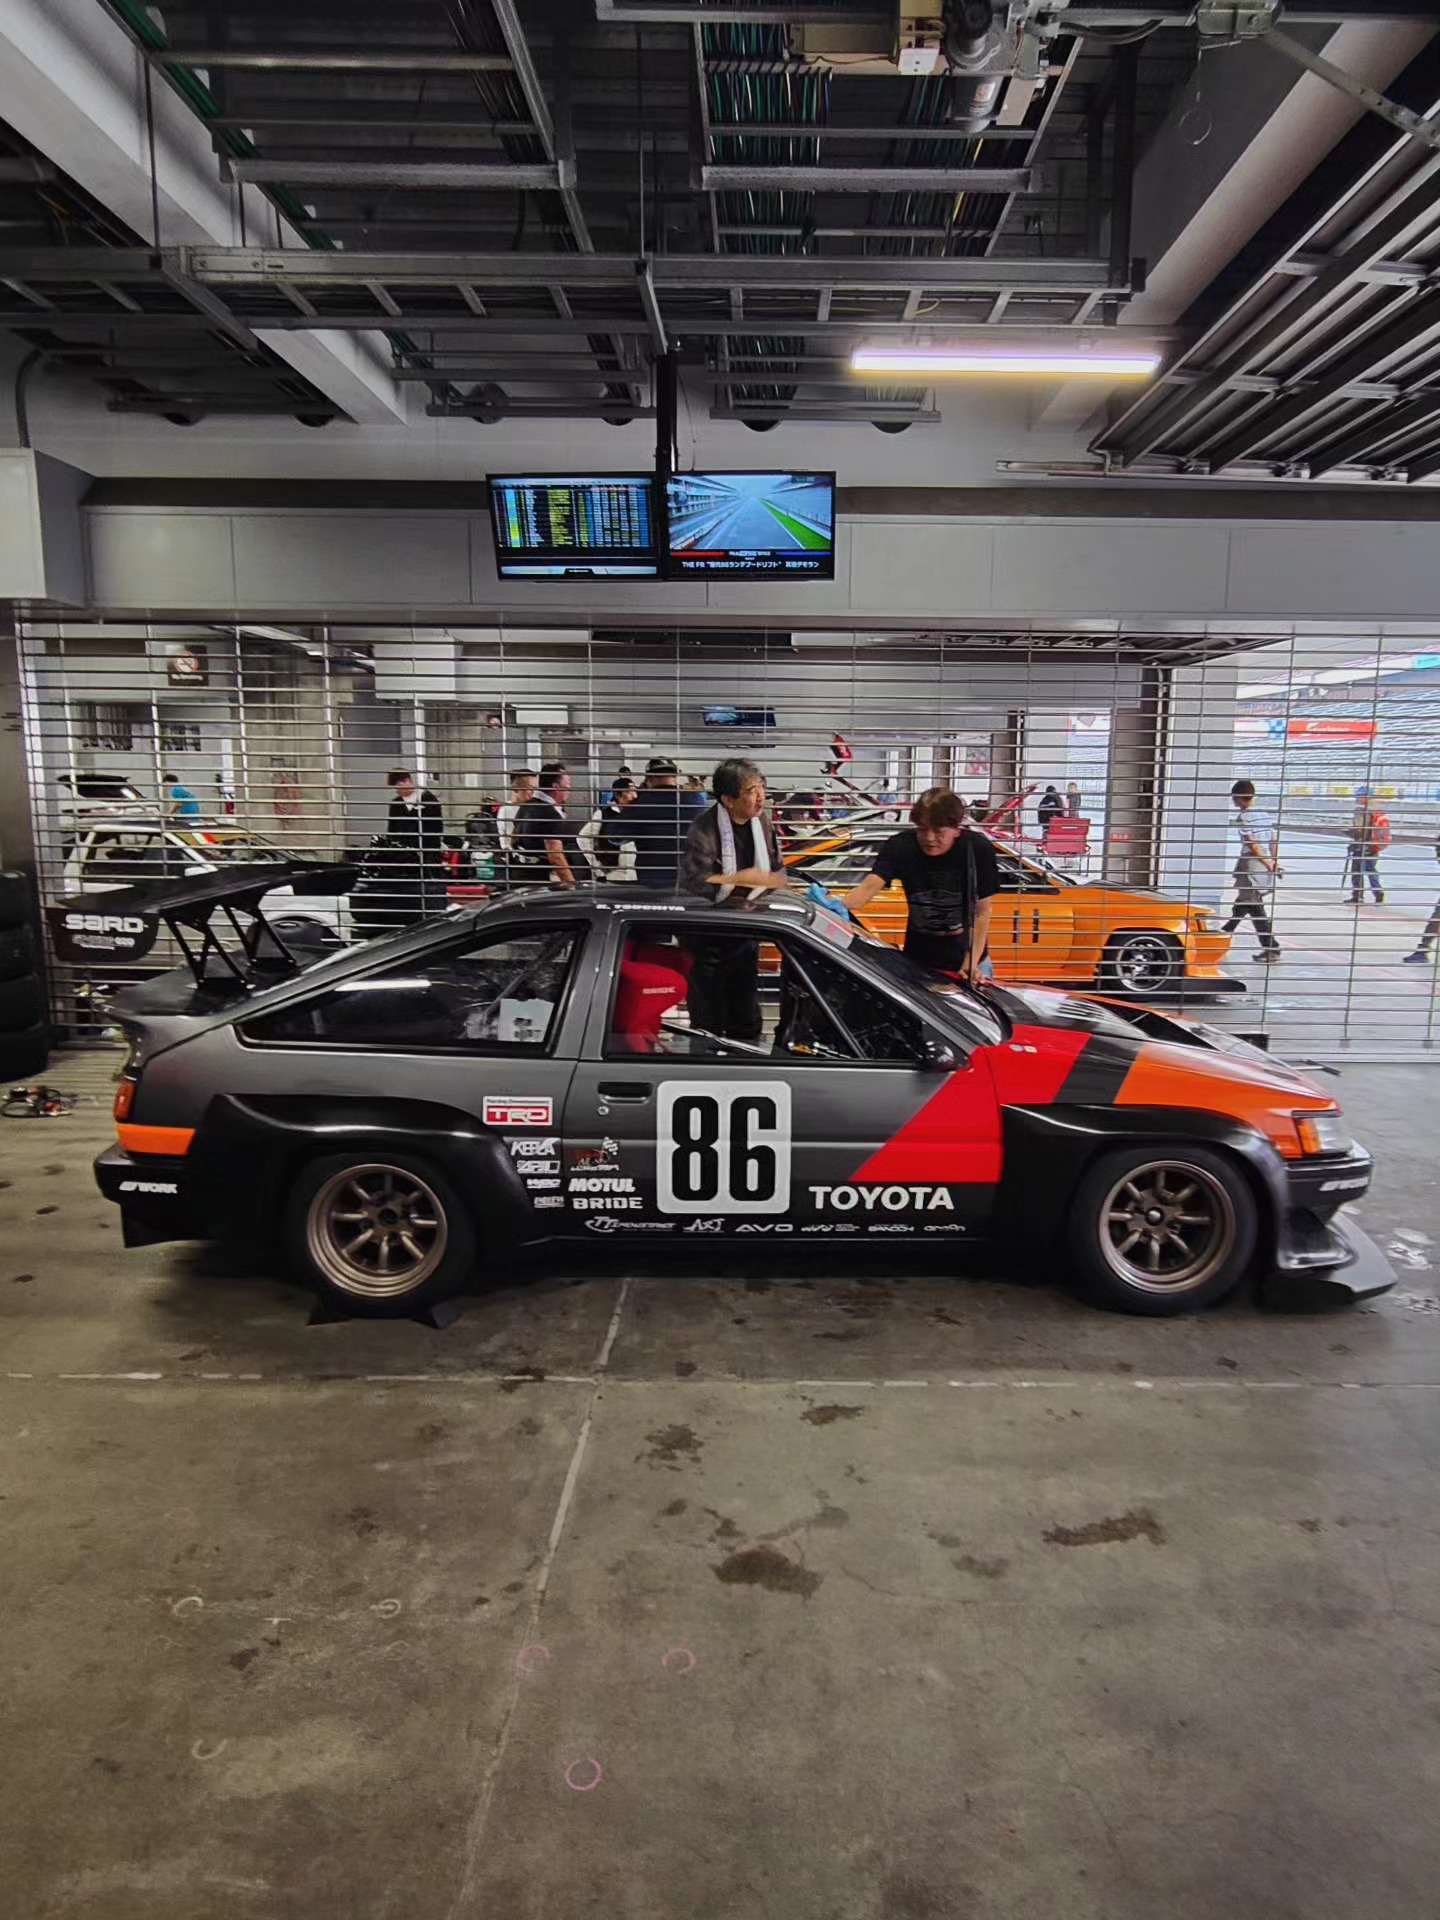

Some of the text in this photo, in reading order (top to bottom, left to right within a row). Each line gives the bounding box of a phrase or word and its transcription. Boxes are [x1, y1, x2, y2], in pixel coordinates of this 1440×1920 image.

[488, 1107, 548, 1122] TRD
[671, 1095, 777, 1202] 86
[568, 1178, 637, 1193] MOTUL
[572, 1196, 644, 1210] BRIDE
[808, 1186, 955, 1211] TOYOTA
